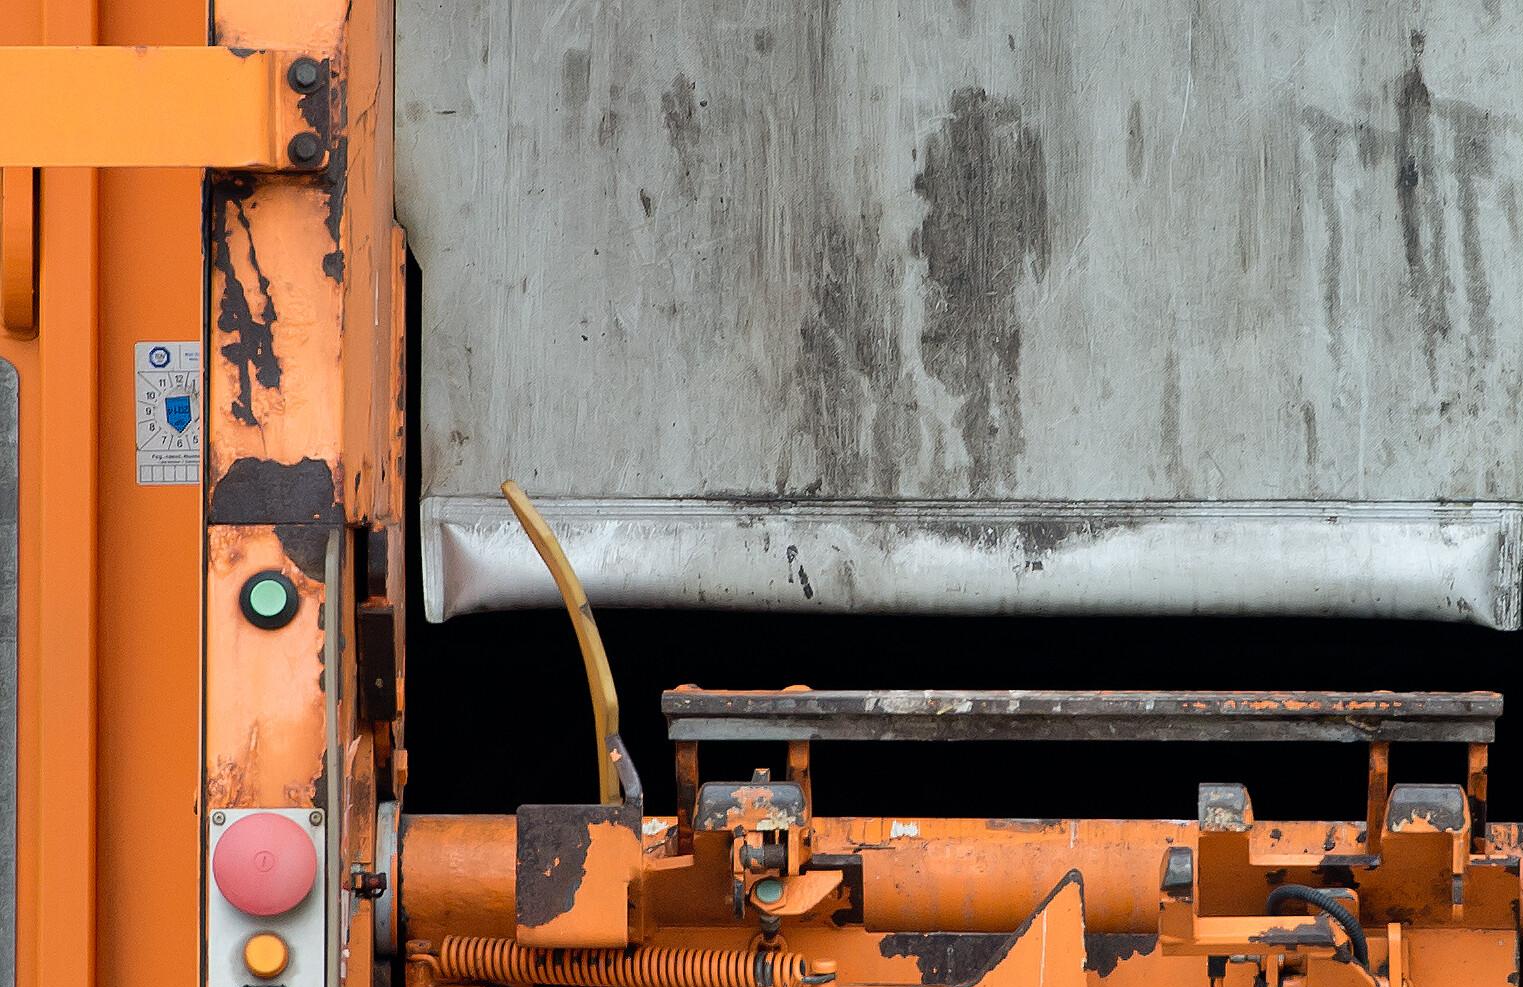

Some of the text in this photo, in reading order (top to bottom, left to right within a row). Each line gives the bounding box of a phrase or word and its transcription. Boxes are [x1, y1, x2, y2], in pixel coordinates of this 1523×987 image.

[159, 379, 167, 387] 11
[175, 375, 184, 383] 12
[146, 392, 156, 400] 10
[145, 407, 152, 416] 9
[150, 422, 156, 432] 8
[162, 436, 167, 445] 7
[177, 438, 183, 448] 6
